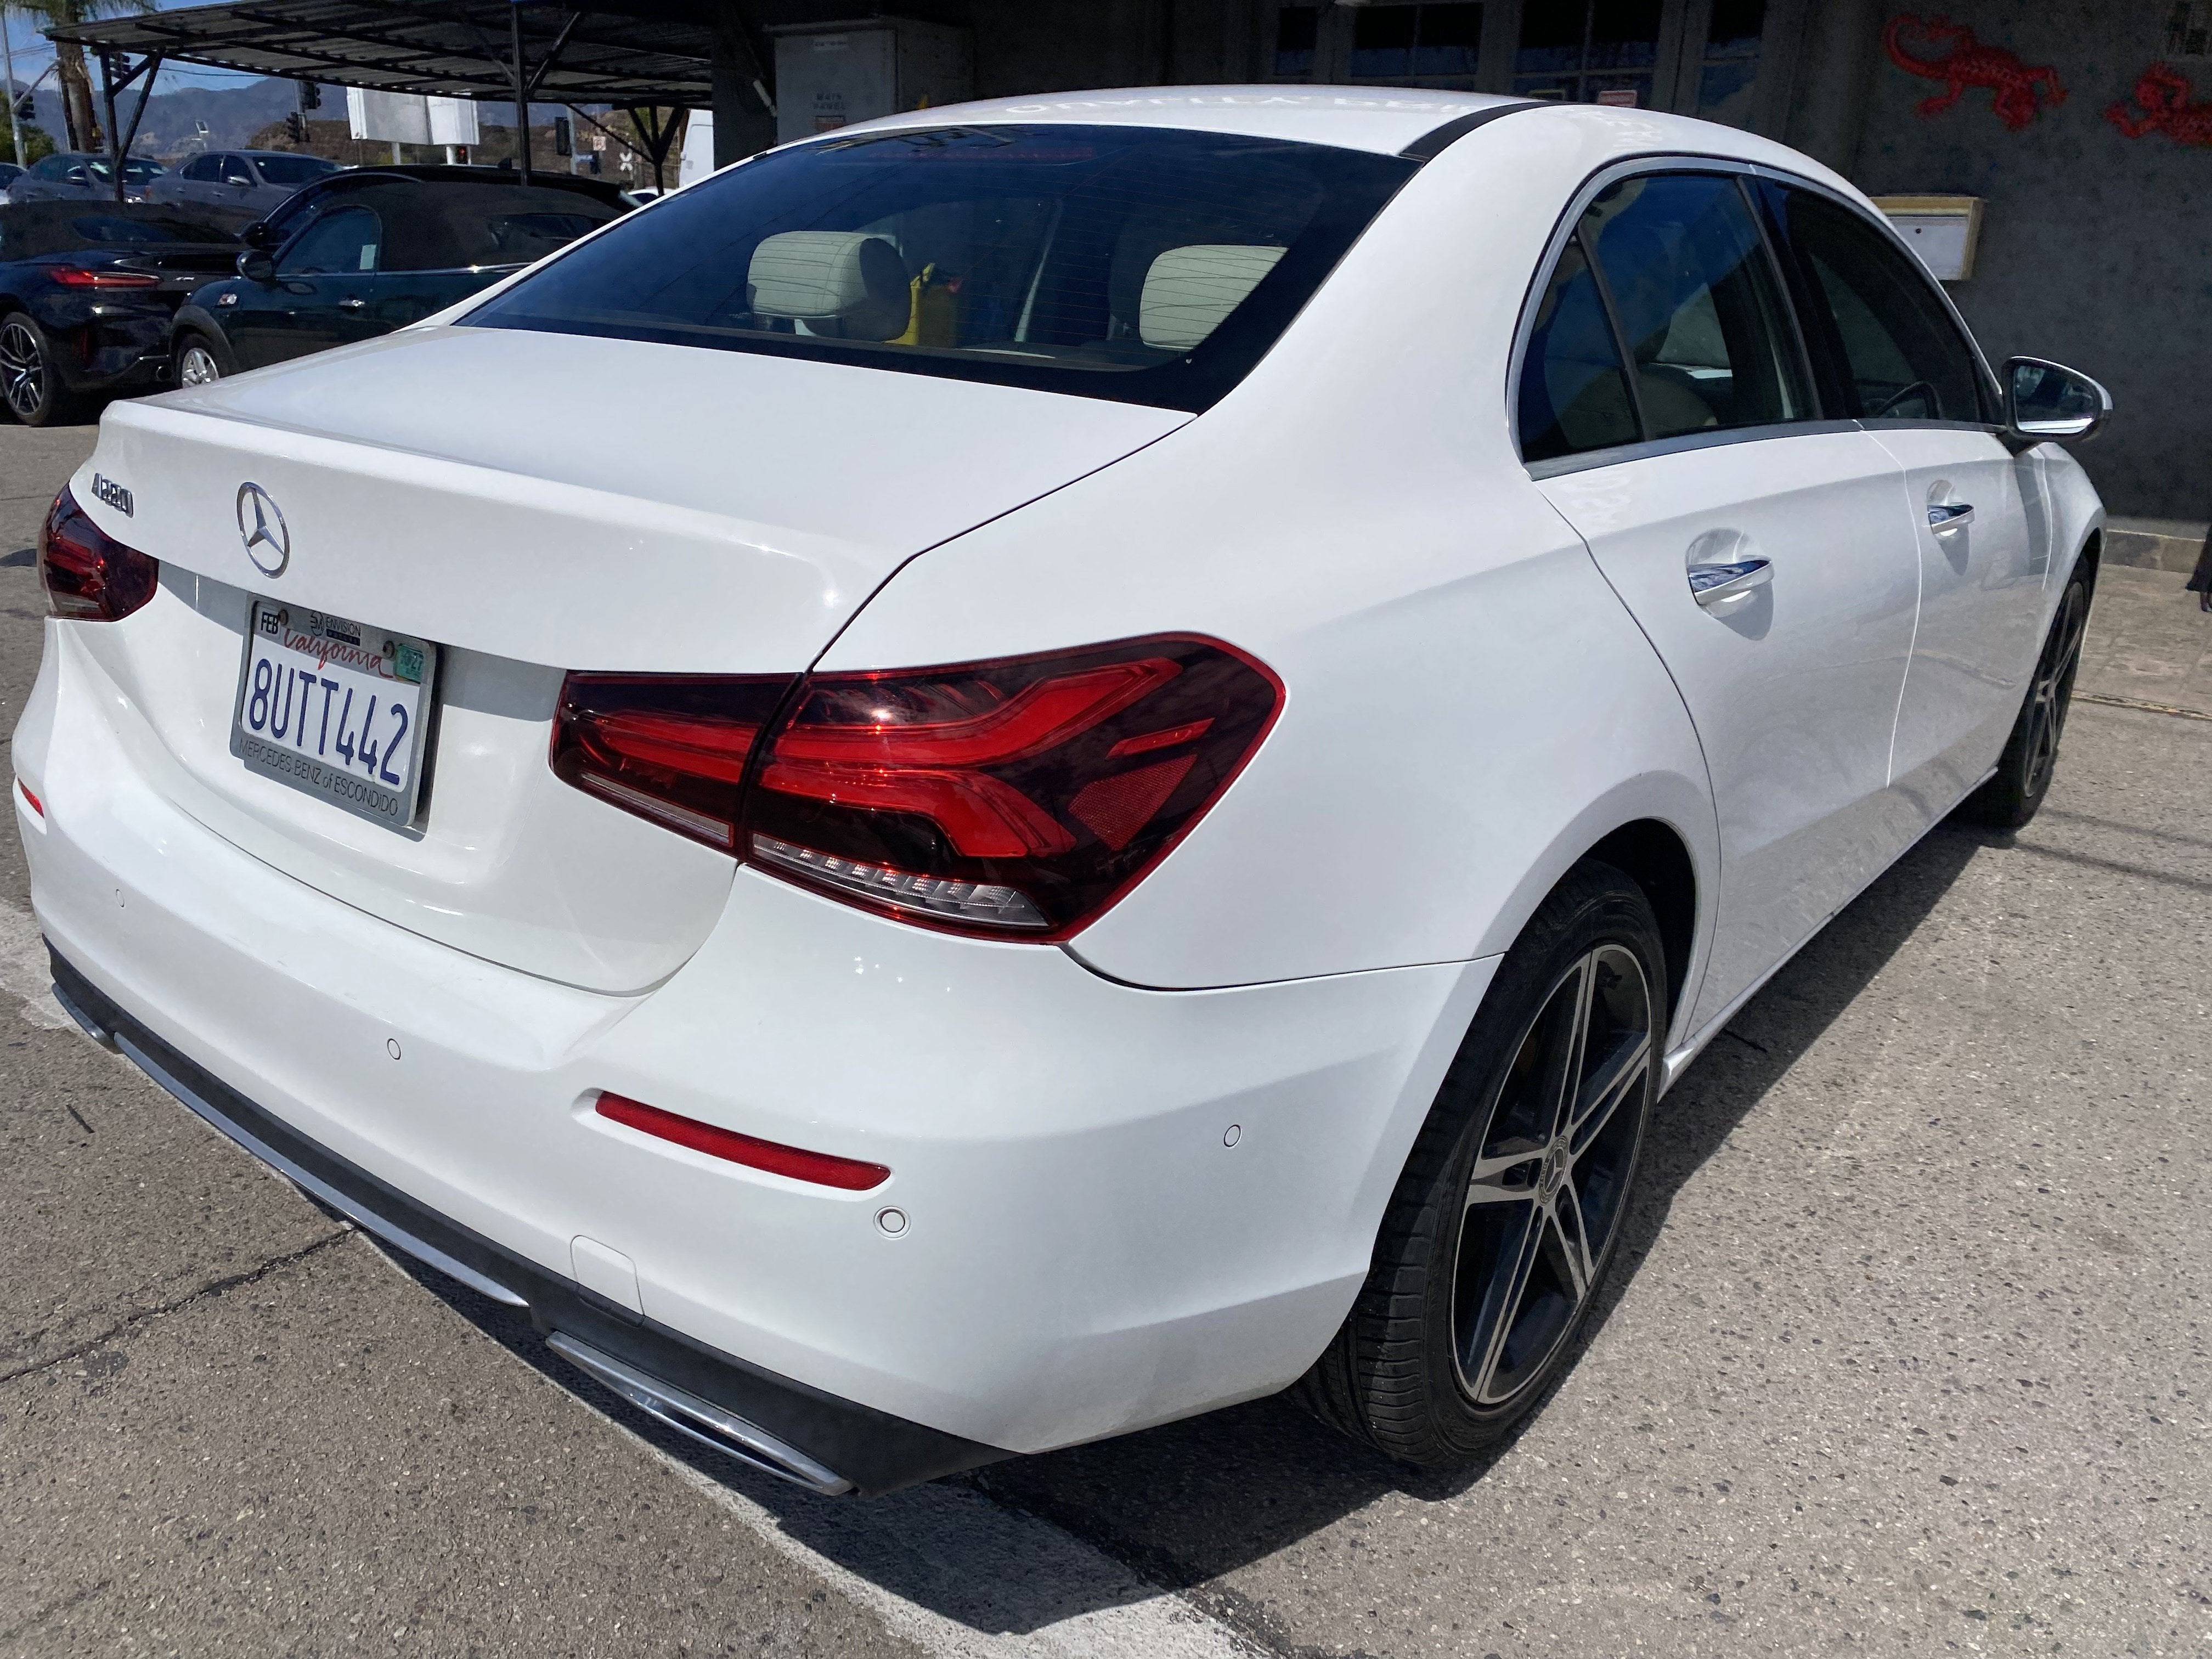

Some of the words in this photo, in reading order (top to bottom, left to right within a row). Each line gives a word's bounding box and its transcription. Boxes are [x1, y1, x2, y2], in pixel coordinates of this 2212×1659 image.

[261, 611, 279, 635] FEB
[325, 616, 362, 637] ENVISION
[284, 628, 394, 679] California
[249, 658, 409, 786] 8UTT442
[323, 773, 334, 788] of
[334, 776, 399, 816] ESCONDIDO
